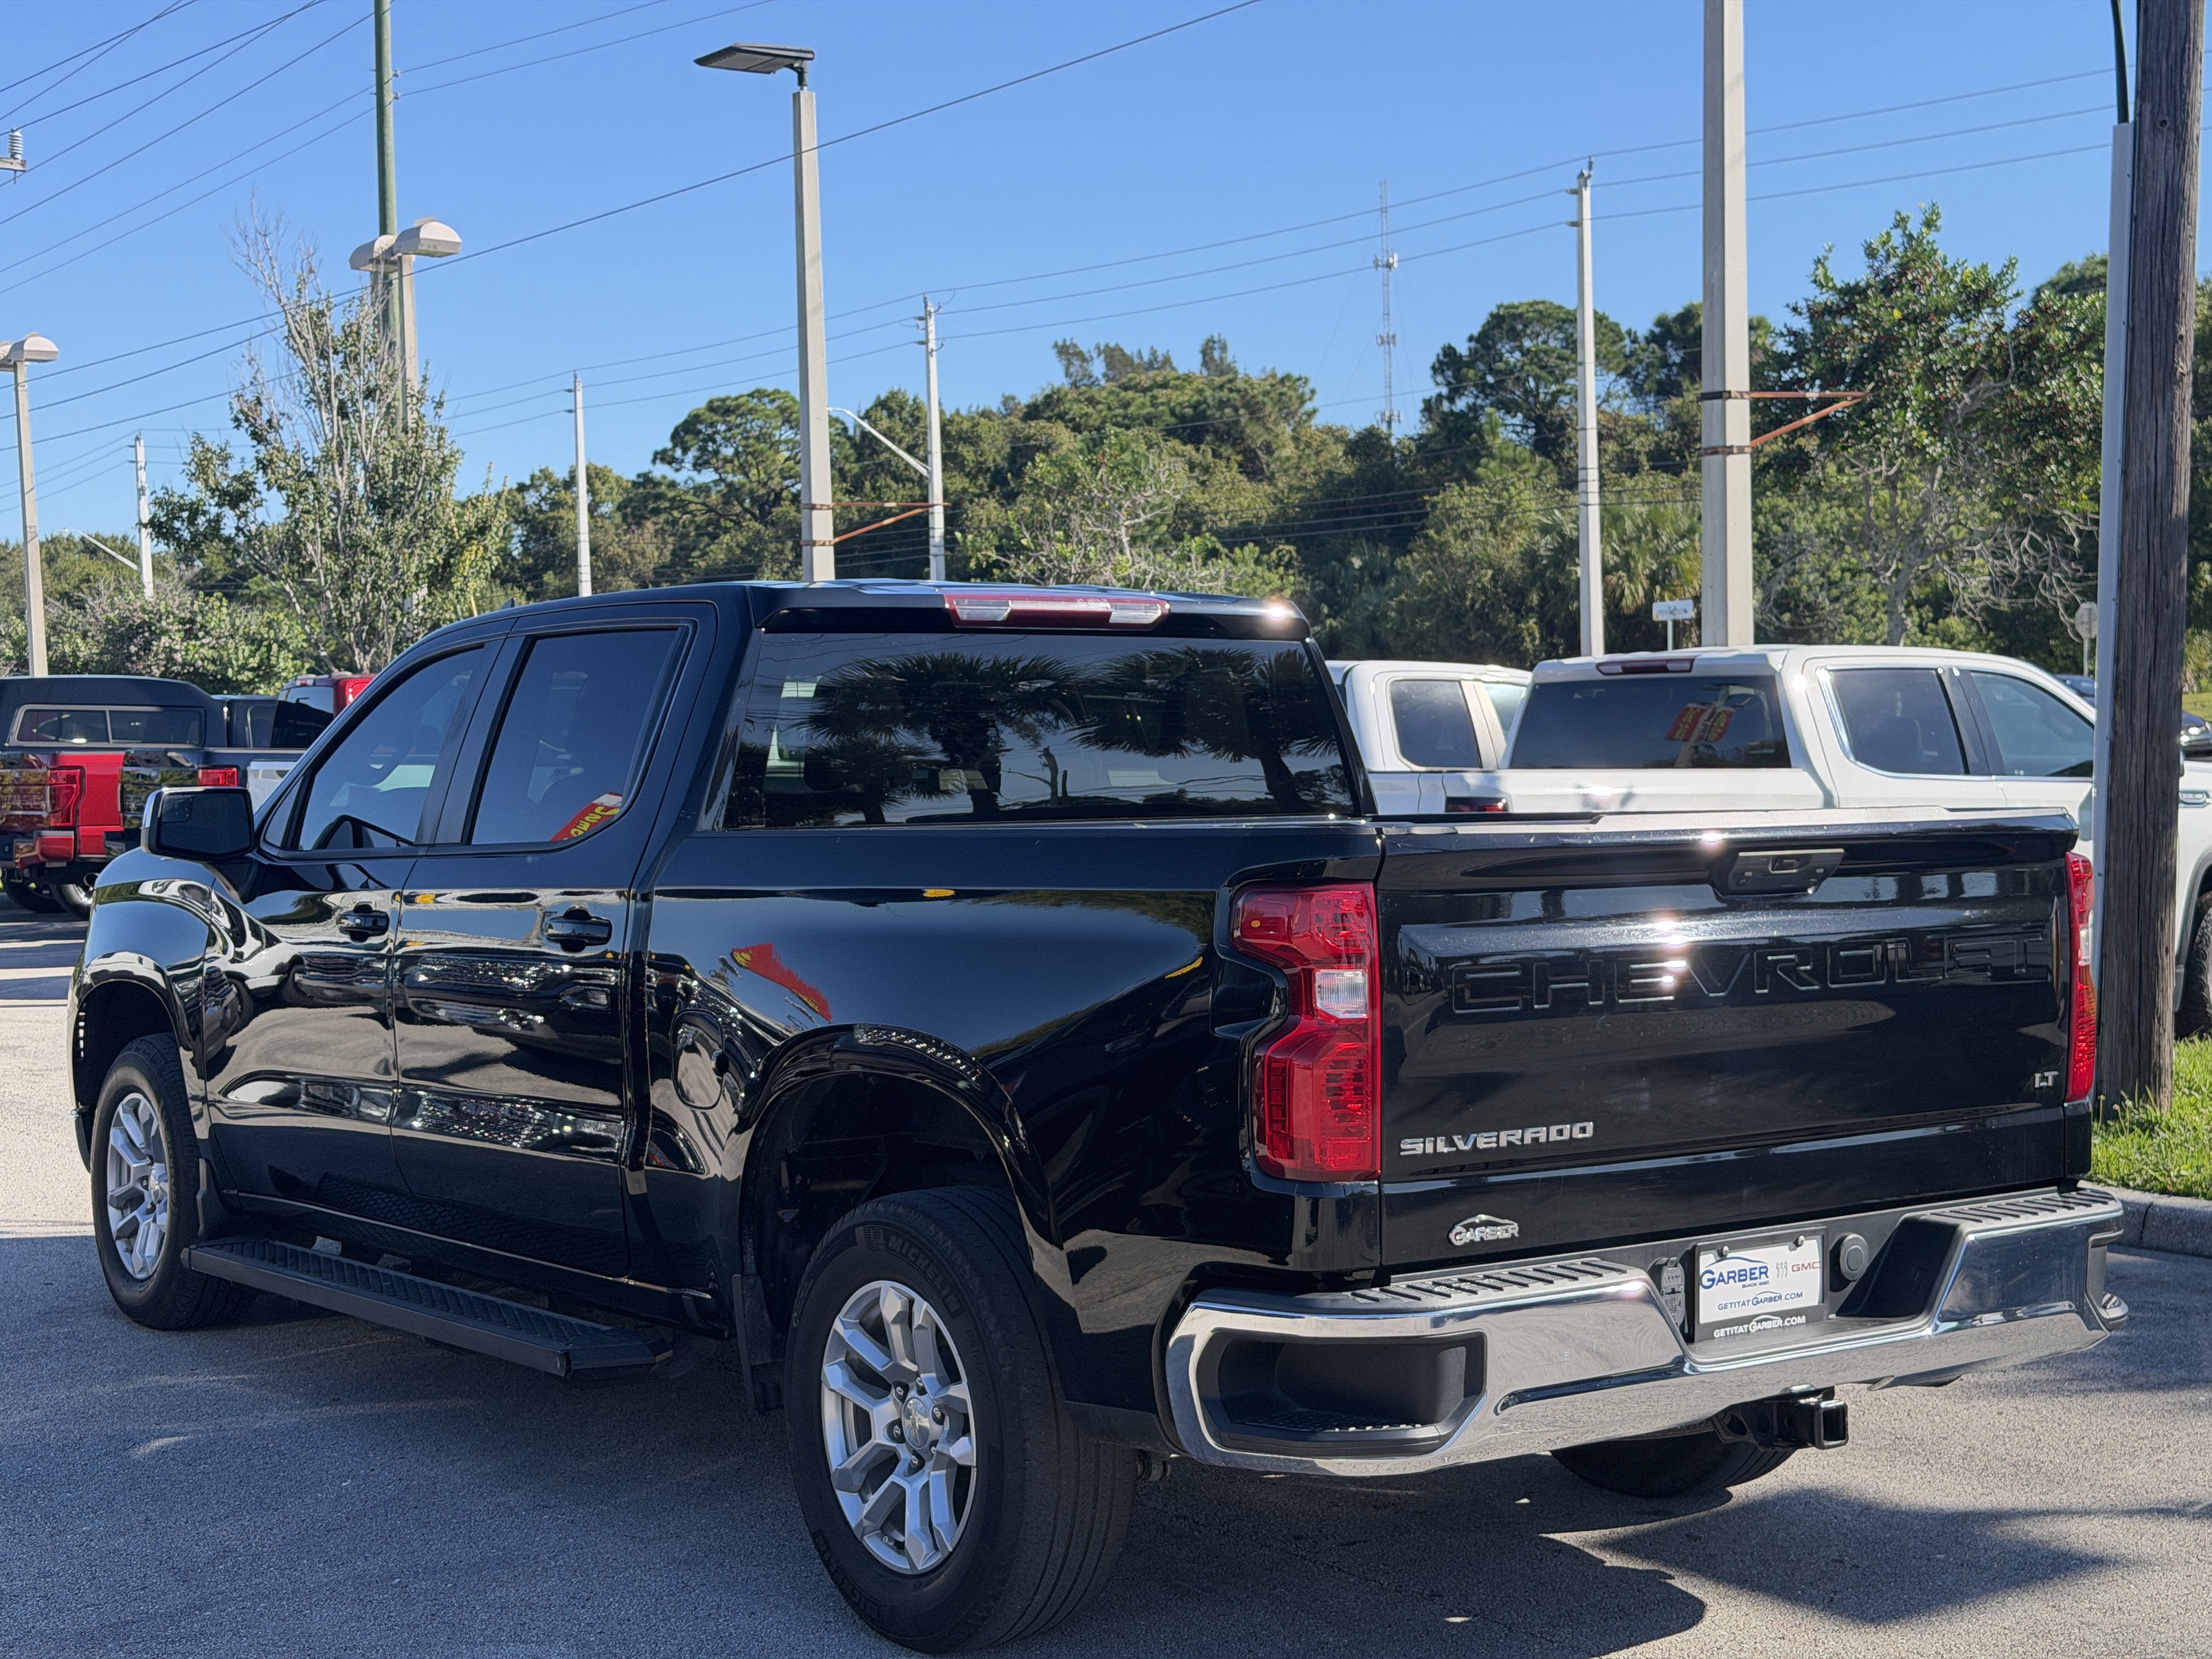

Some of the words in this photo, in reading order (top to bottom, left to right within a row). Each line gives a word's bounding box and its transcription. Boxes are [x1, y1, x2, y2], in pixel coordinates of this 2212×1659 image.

[1452, 932, 2044, 1013] CHEVROLET
[2035, 1071, 2059, 1088] LT
[1400, 1121, 1594, 1155] SILVERADO
[1449, 1224, 1520, 1246] GARBER
[888, 1234, 961, 1312] MICHELIN
[1700, 1265, 1769, 1290] GARBER
[1791, 1261, 1820, 1272] GMC
[1717, 1291, 1804, 1311] GETITATGARBER.COM
[1713, 1315, 1806, 1339] GETITATGARBER.COM
